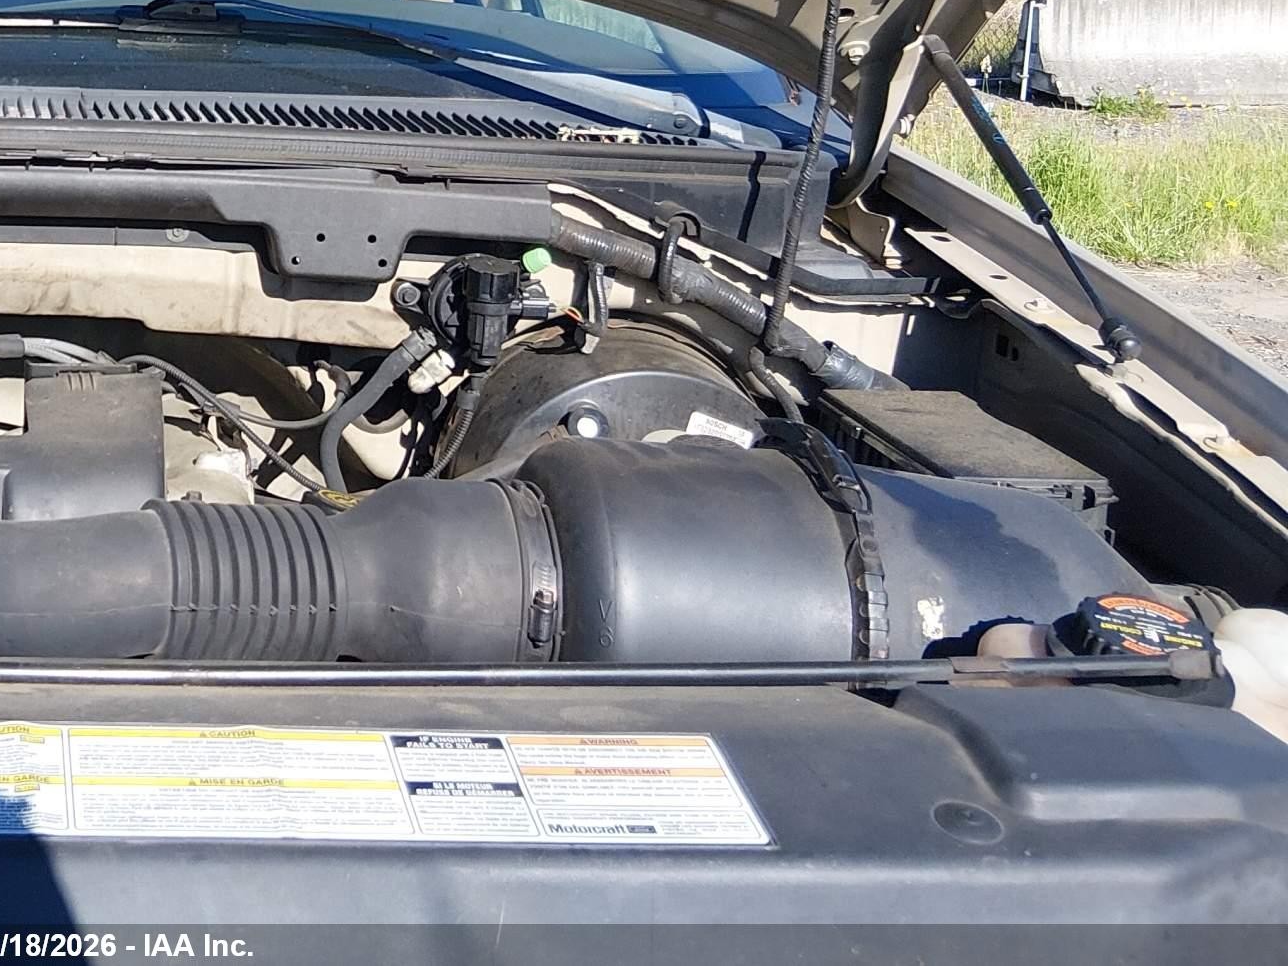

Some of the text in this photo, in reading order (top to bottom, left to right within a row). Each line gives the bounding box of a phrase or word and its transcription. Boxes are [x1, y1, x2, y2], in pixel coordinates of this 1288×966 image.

[586, 738, 639, 746] WARNING
[580, 768, 673, 776] AVERTISSEMENT
[14, 774, 50, 782] GARDE
[248, 778, 284, 786] GARDE
[548, 823, 627, 834] Motorcraft
